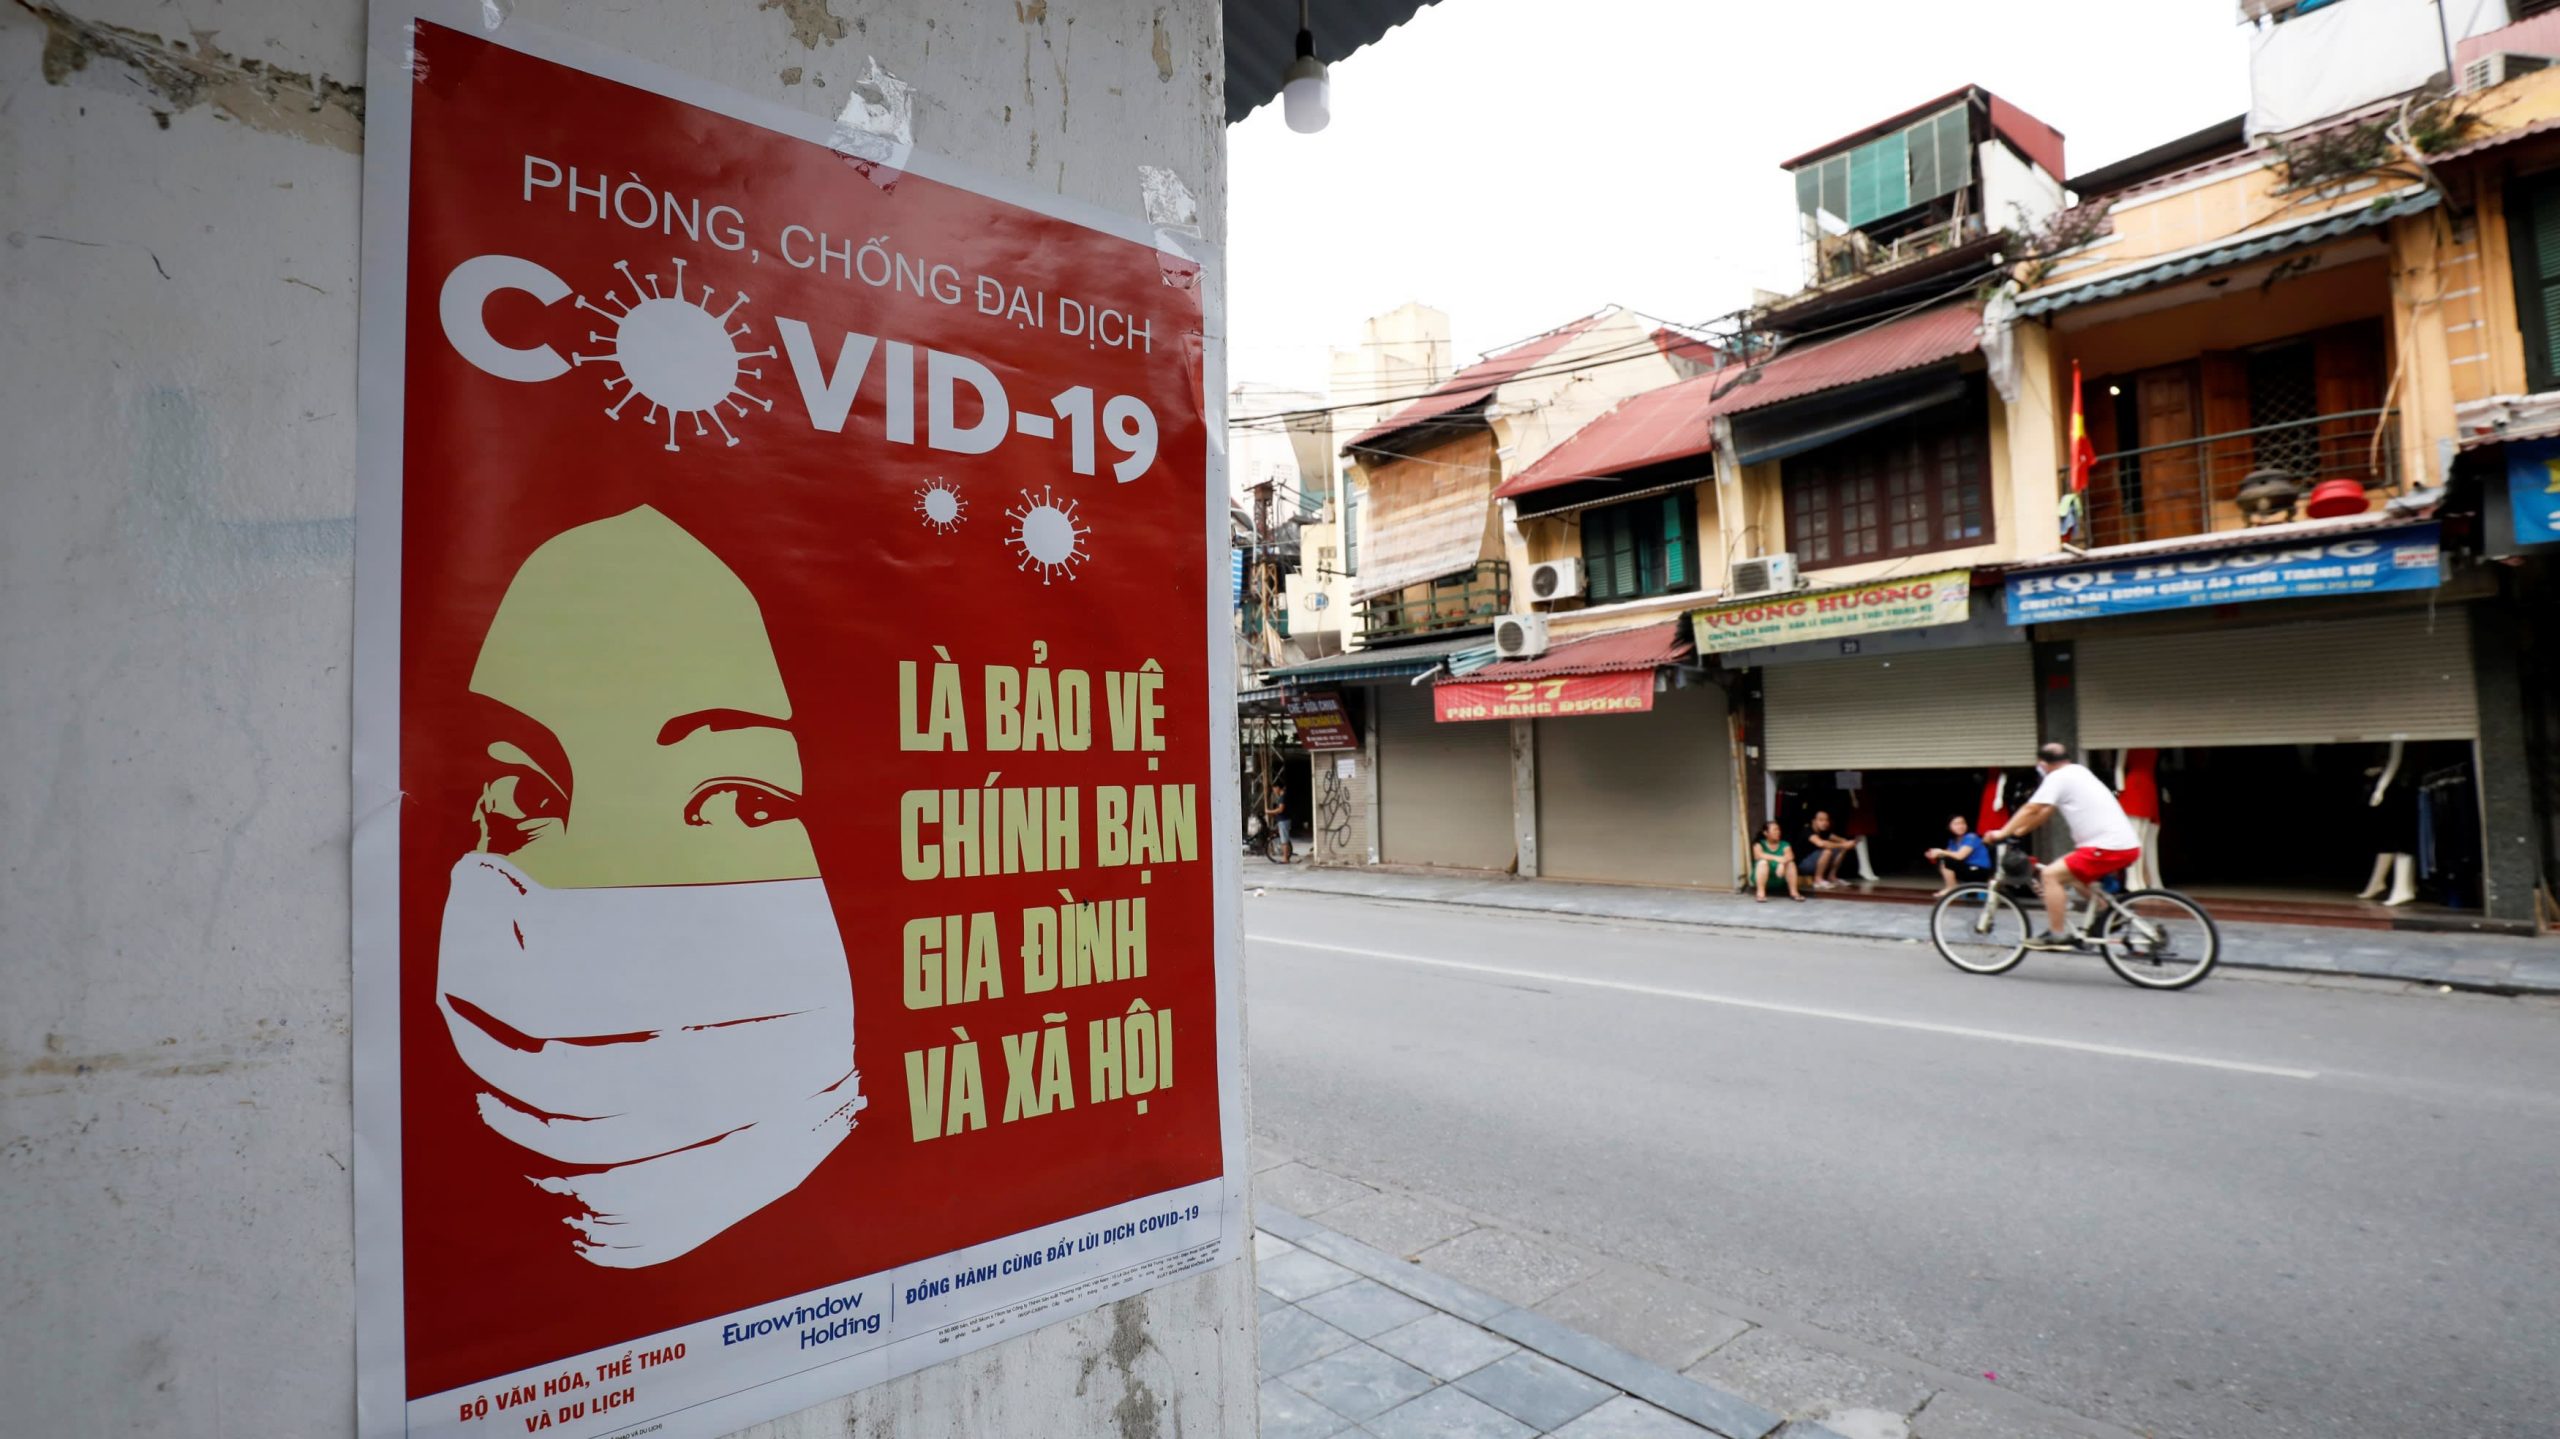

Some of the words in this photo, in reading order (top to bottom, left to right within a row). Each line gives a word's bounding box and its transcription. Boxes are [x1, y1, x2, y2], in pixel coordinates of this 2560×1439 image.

[522, 154, 760, 263] PHÒNG,
[781, 224, 962, 305] CHỐNG
[976, 274, 1044, 329] ĐẠI
[1060, 296, 1152, 354] DỊCH
[899, 645, 969, 752] LÀ
[984, 640, 1092, 752] BẢO
[1105, 658, 1166, 771] VỆ
[1503, 678, 1569, 703] 27
[900, 772, 1080, 881] CHÍNH
[1096, 784, 1198, 884] BẠN
[903, 911, 1004, 1010] GIA
[1021, 888, 1148, 995] ĐÌNH
[904, 1026, 987, 1143] VÀ
[1001, 1011, 1075, 1123] XÃ
[1089, 998, 1173, 1115] HỘI
[906, 1278, 950, 1305] ĐỒNG
[955, 1261, 998, 1290] HÀNH
[1002, 1248, 1042, 1276] CÙNG
[1078, 1231, 1100, 1253] LÙI
[1103, 1222, 1135, 1246] DỊCH
[1139, 1205, 1200, 1234] COVID-19
[722, 1293, 863, 1346] Eurowindow
[800, 1313, 881, 1350] Holding
[460, 1395, 488, 1422] BỘ
[495, 1385, 536, 1411] VĂN
[544, 1371, 591, 1397] HÓA,
[596, 1350, 633, 1382] THỂ
[638, 1343, 687, 1370] THAO
[525, 1409, 552, 1433] VÀ
[558, 1402, 585, 1424] DU
[591, 1387, 636, 1415] LỊCH
